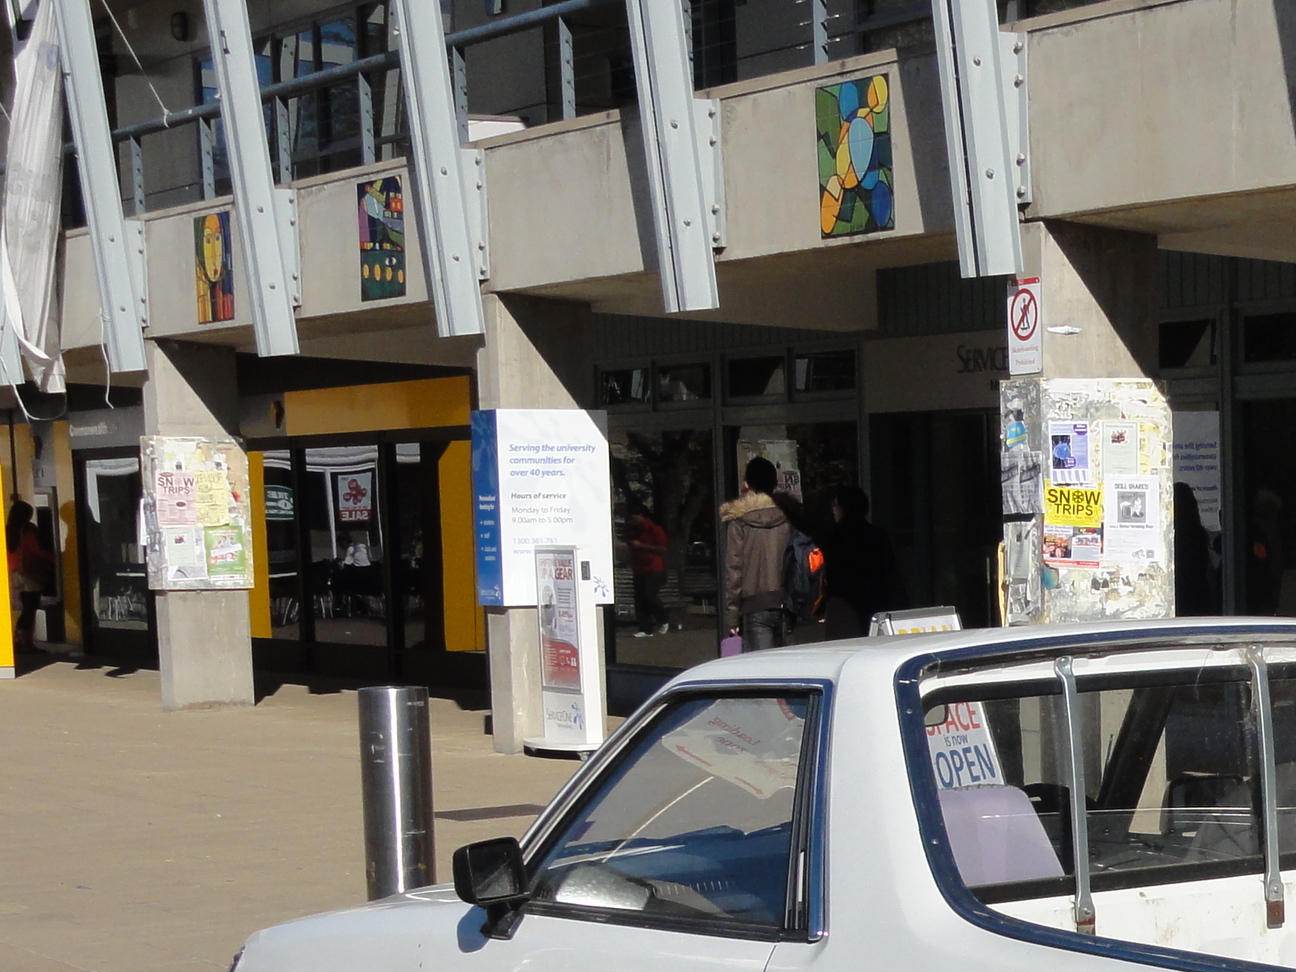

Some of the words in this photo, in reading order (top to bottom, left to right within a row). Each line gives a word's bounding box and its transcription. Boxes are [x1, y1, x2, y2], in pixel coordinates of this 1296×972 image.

[509, 443, 540, 453] Serving
[541, 444, 554, 452] the
[556, 443, 596, 453] university
[509, 456, 562, 464] communities
[563, 456, 575, 464] for
[530, 468, 541, 476] 40
[541, 470, 565, 478] years.
[163, 486, 190, 494] TRIPS
[511, 506, 539, 514] Monday
[550, 506, 571, 514] Friday
[1054, 504, 1093, 516] TRIPS
[555, 568, 573, 580] GEAR
[943, 734, 951, 747] is
[952, 734, 968, 747] now
[935, 743, 996, 788] OPEN
